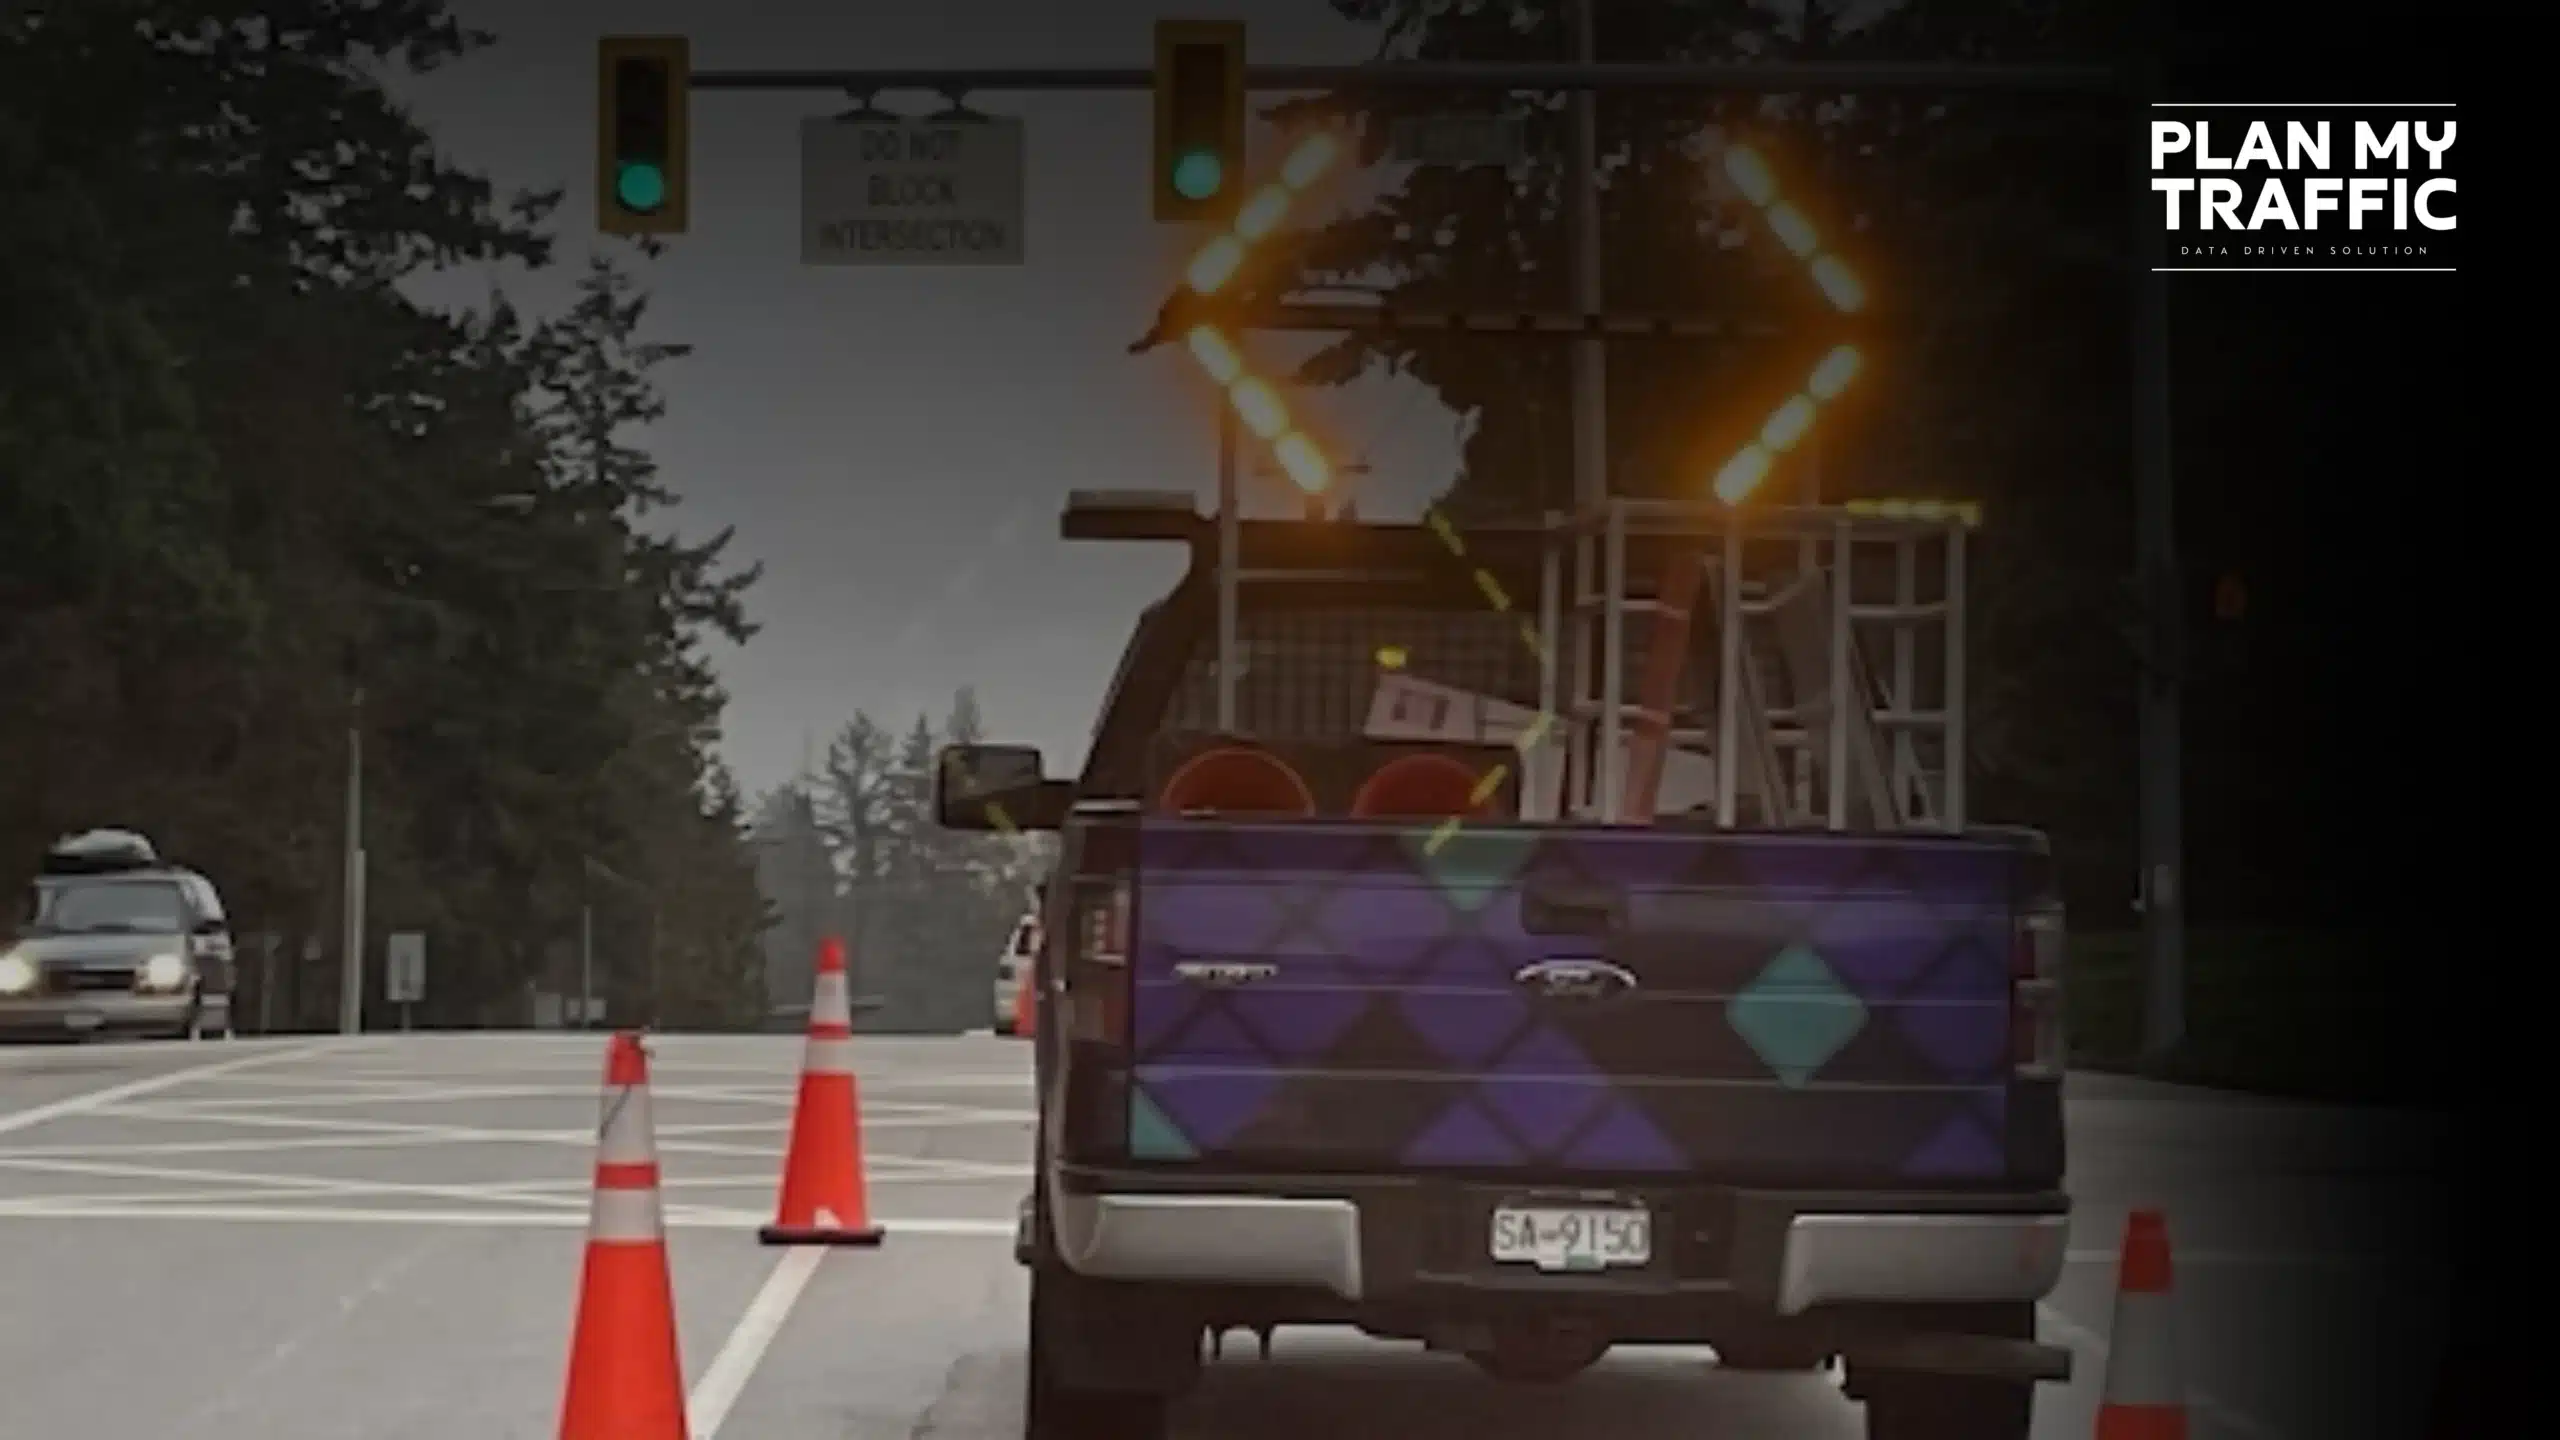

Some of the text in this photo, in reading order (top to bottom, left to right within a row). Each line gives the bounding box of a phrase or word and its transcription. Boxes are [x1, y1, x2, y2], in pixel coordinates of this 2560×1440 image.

[860, 128, 961, 161] DO NOT
[868, 174, 956, 207] BLOCK
[818, 218, 1006, 251] INTERSECTION
[1498, 1213, 1648, 1255] SA-9150
